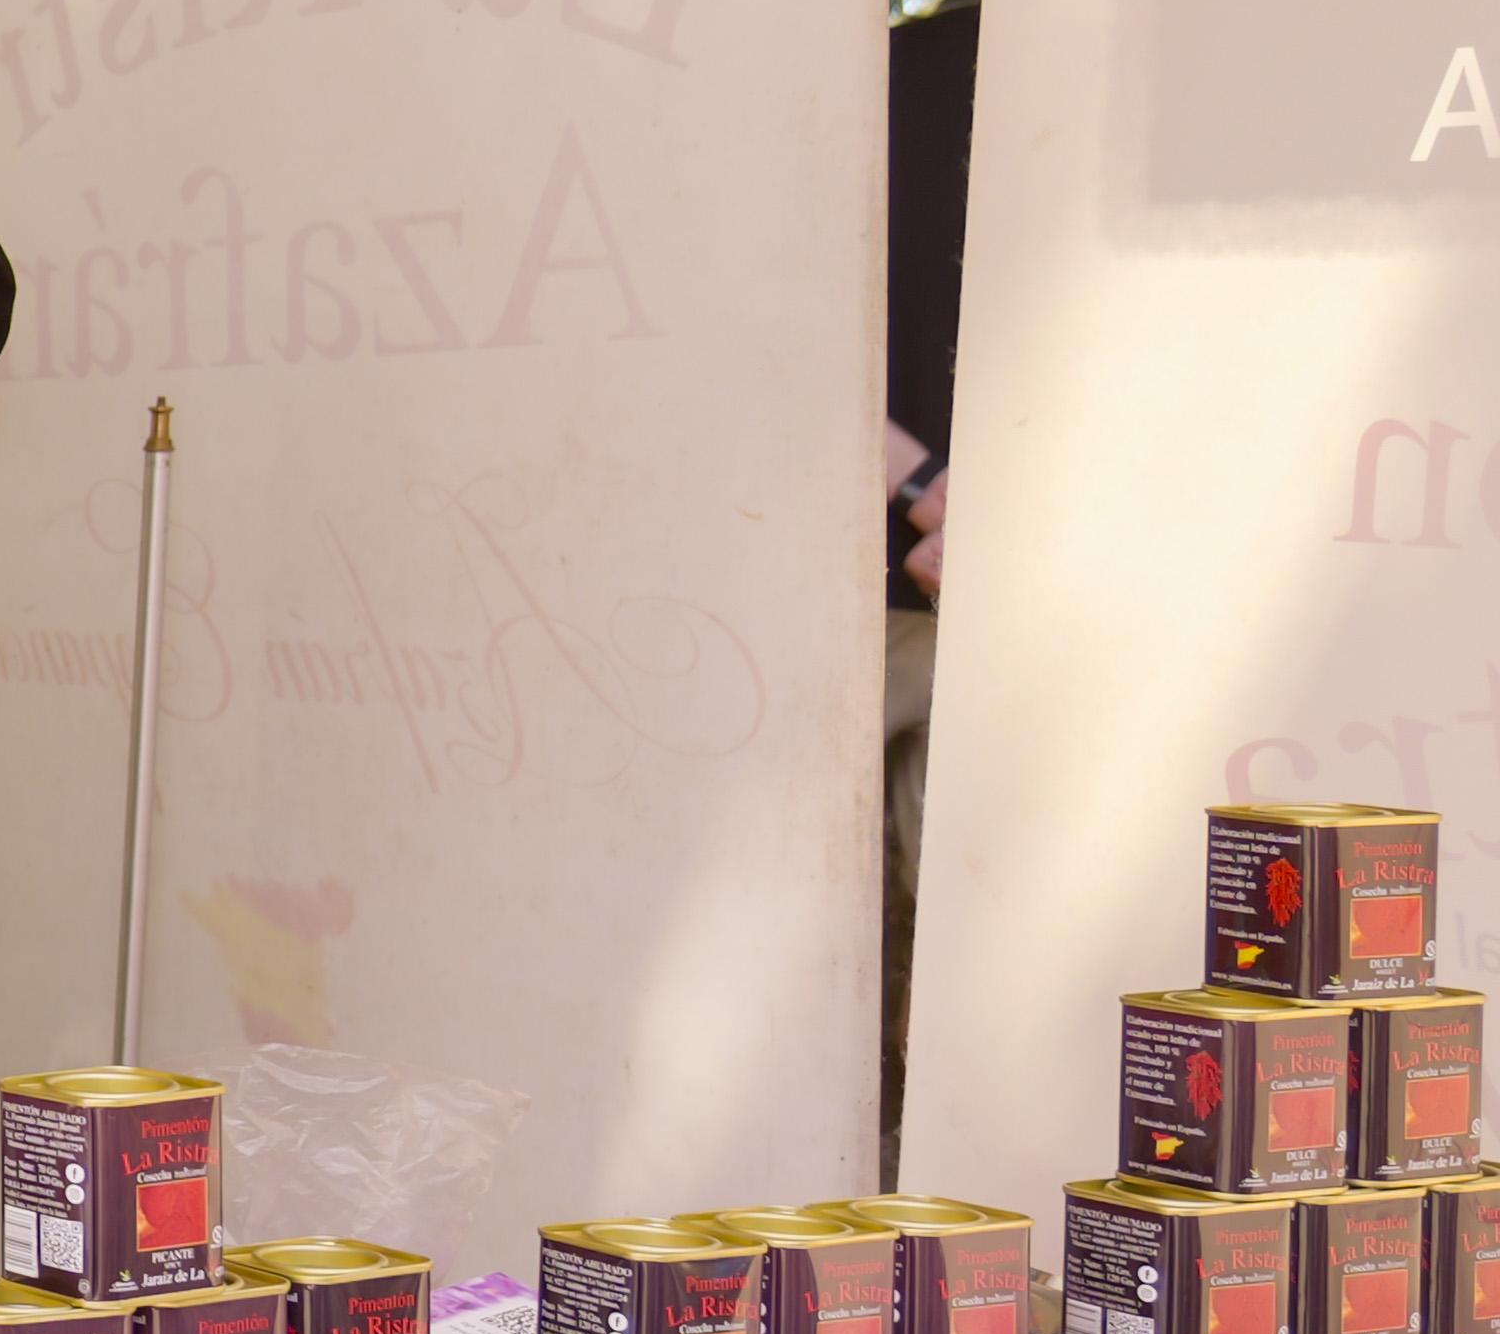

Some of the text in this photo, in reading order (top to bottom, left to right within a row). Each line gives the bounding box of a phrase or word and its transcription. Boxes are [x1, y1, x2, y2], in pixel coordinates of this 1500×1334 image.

[1256, 1053, 1344, 1082] La Ristra
[140, 1116, 209, 1139] Pimentón
[122, 1139, 218, 1176] La Ristra
[1286, 1150, 1316, 1162] DULCE
[152, 1249, 194, 1262] PICANTE
[175, 1270, 188, 1283] de
[190, 1268, 204, 1280] La
[666, 1305, 694, 1327] La
